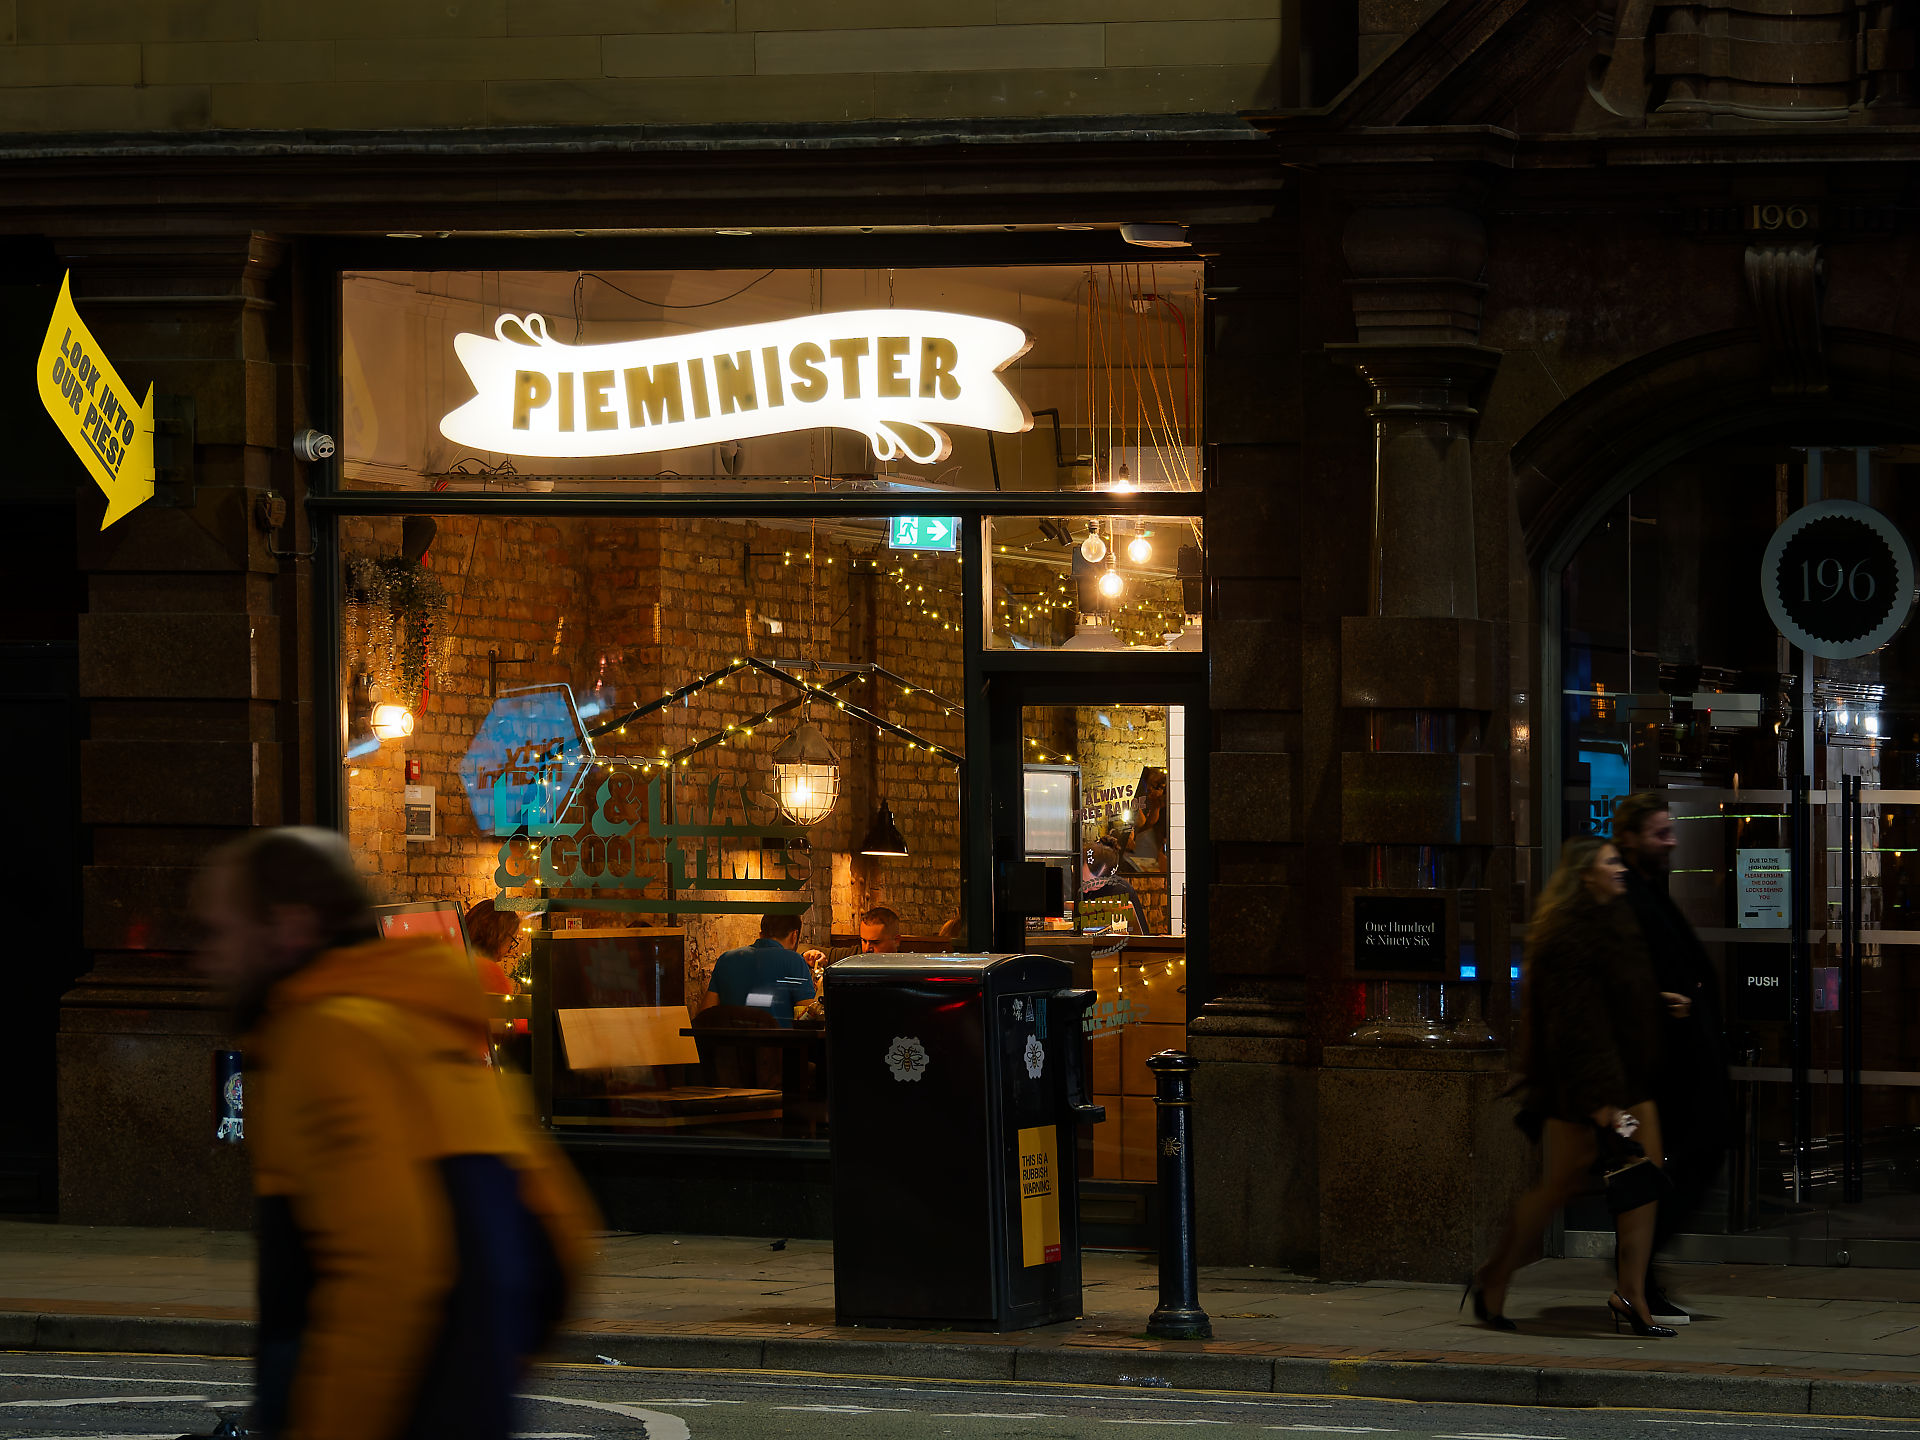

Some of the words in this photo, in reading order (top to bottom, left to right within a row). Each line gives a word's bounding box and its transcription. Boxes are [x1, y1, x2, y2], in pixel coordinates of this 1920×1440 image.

[1751, 203, 1808, 230] 196
[60, 327, 101, 395] LOOK
[98, 383, 135, 446] INTO
[512, 336, 962, 432] PIEMINISTER
[52, 356, 83, 415] OUR
[83, 402, 126, 474] PIES!
[1799, 556, 1877, 603] 196
[1085, 785, 1134, 805] ALWAYS
[1105, 796, 1147, 817] RANGE
[666, 836, 813, 890] TIMES
[1365, 921, 1387, 932] One
[1389, 921, 1435, 933] Hundred
[1365, 934, 1375, 945] &
[1377, 934, 1411, 949] Ninety
[1413, 935, 1430, 946] Six
[1747, 976, 1779, 987] PUSH
[1081, 1003, 1099, 1018] AT
[1082, 1017, 1103, 1033] AKE
[1021, 1154, 1036, 1167] THIS
[1036, 1153, 1043, 1165] IS
[1043, 1152, 1049, 1164] A
[1022, 1166, 1048, 1181] RUBBISH
[1022, 1180, 1052, 1195] WARNING.
